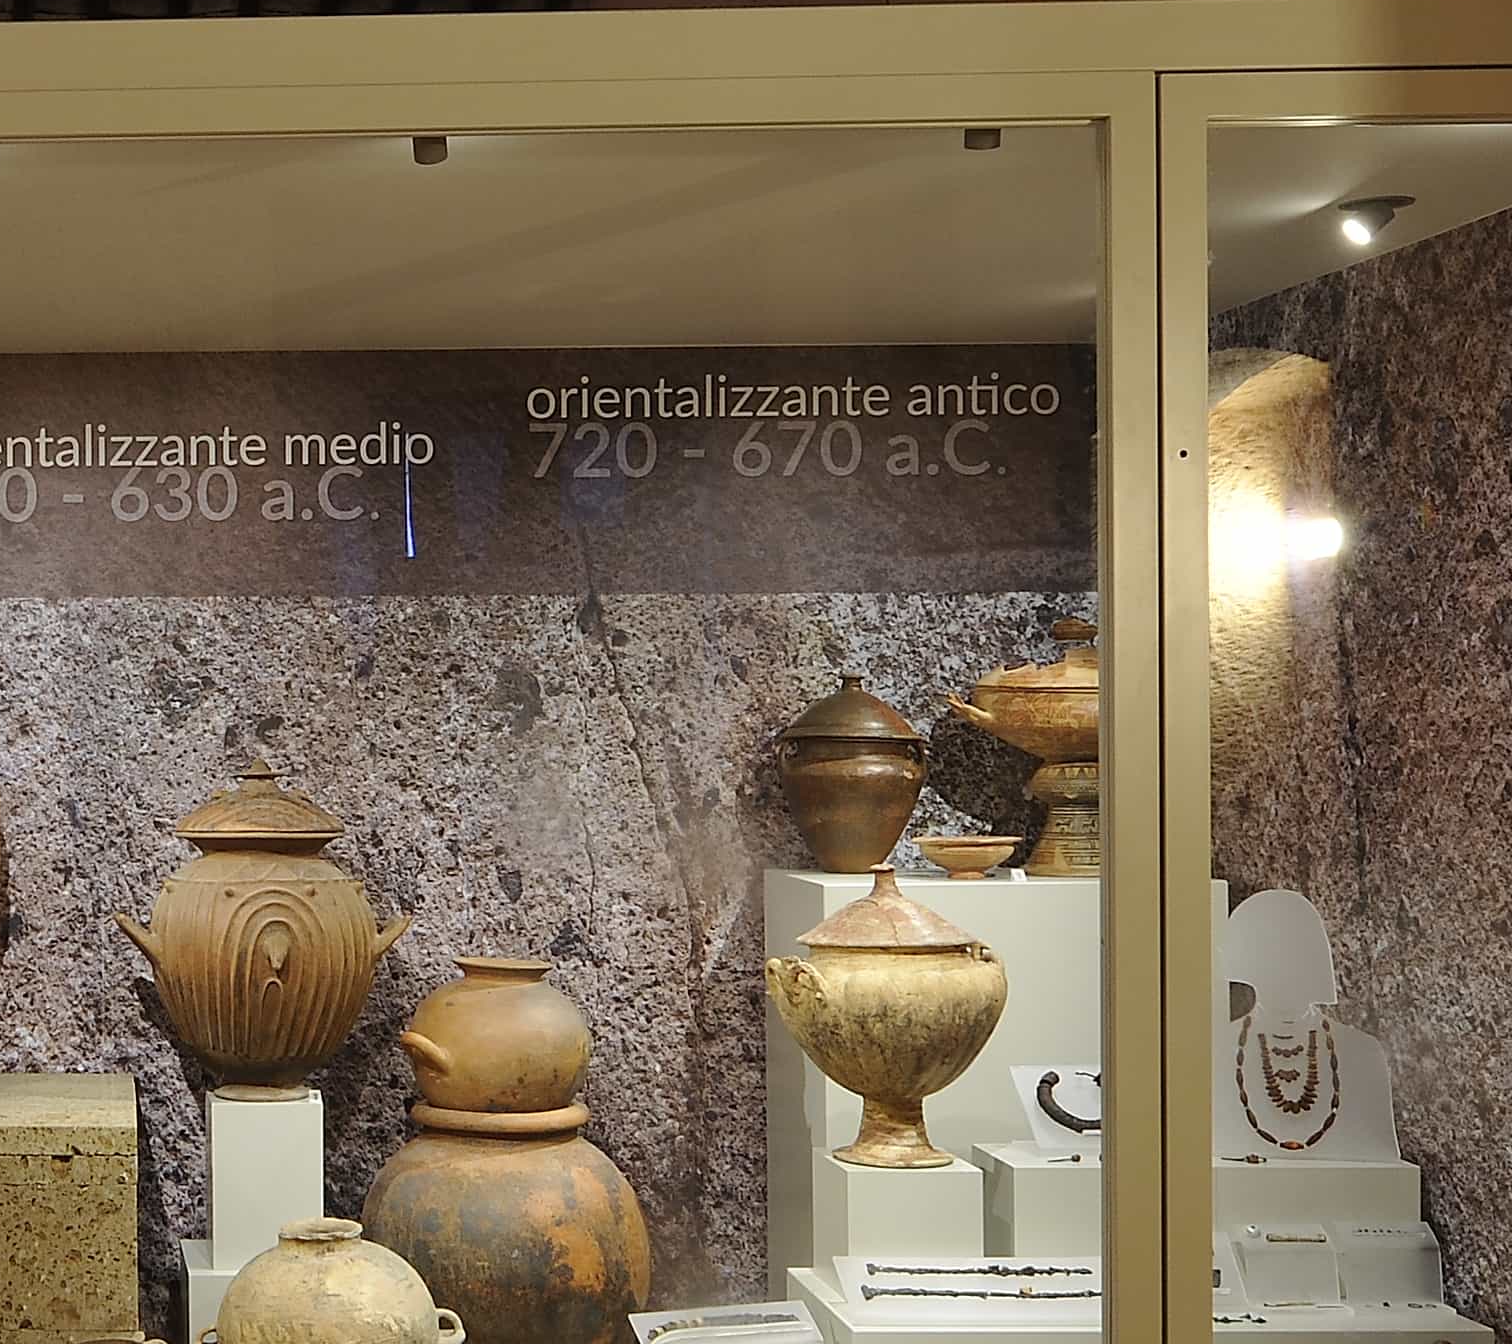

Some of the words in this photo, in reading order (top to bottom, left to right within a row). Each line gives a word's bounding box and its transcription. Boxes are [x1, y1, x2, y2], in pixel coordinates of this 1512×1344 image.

[526, 374, 890, 419] orientalizzante
[907, 373, 1060, 416] antico
[285, 422, 434, 465] medio
[528, 421, 657, 479] 720
[683, 448, 705, 458] -
[732, 420, 862, 478] 670
[886, 419, 1007, 477] a.C.
[62, 494, 85, 504] -
[110, 465, 238, 522] 630
[261, 465, 380, 521] a.C.
